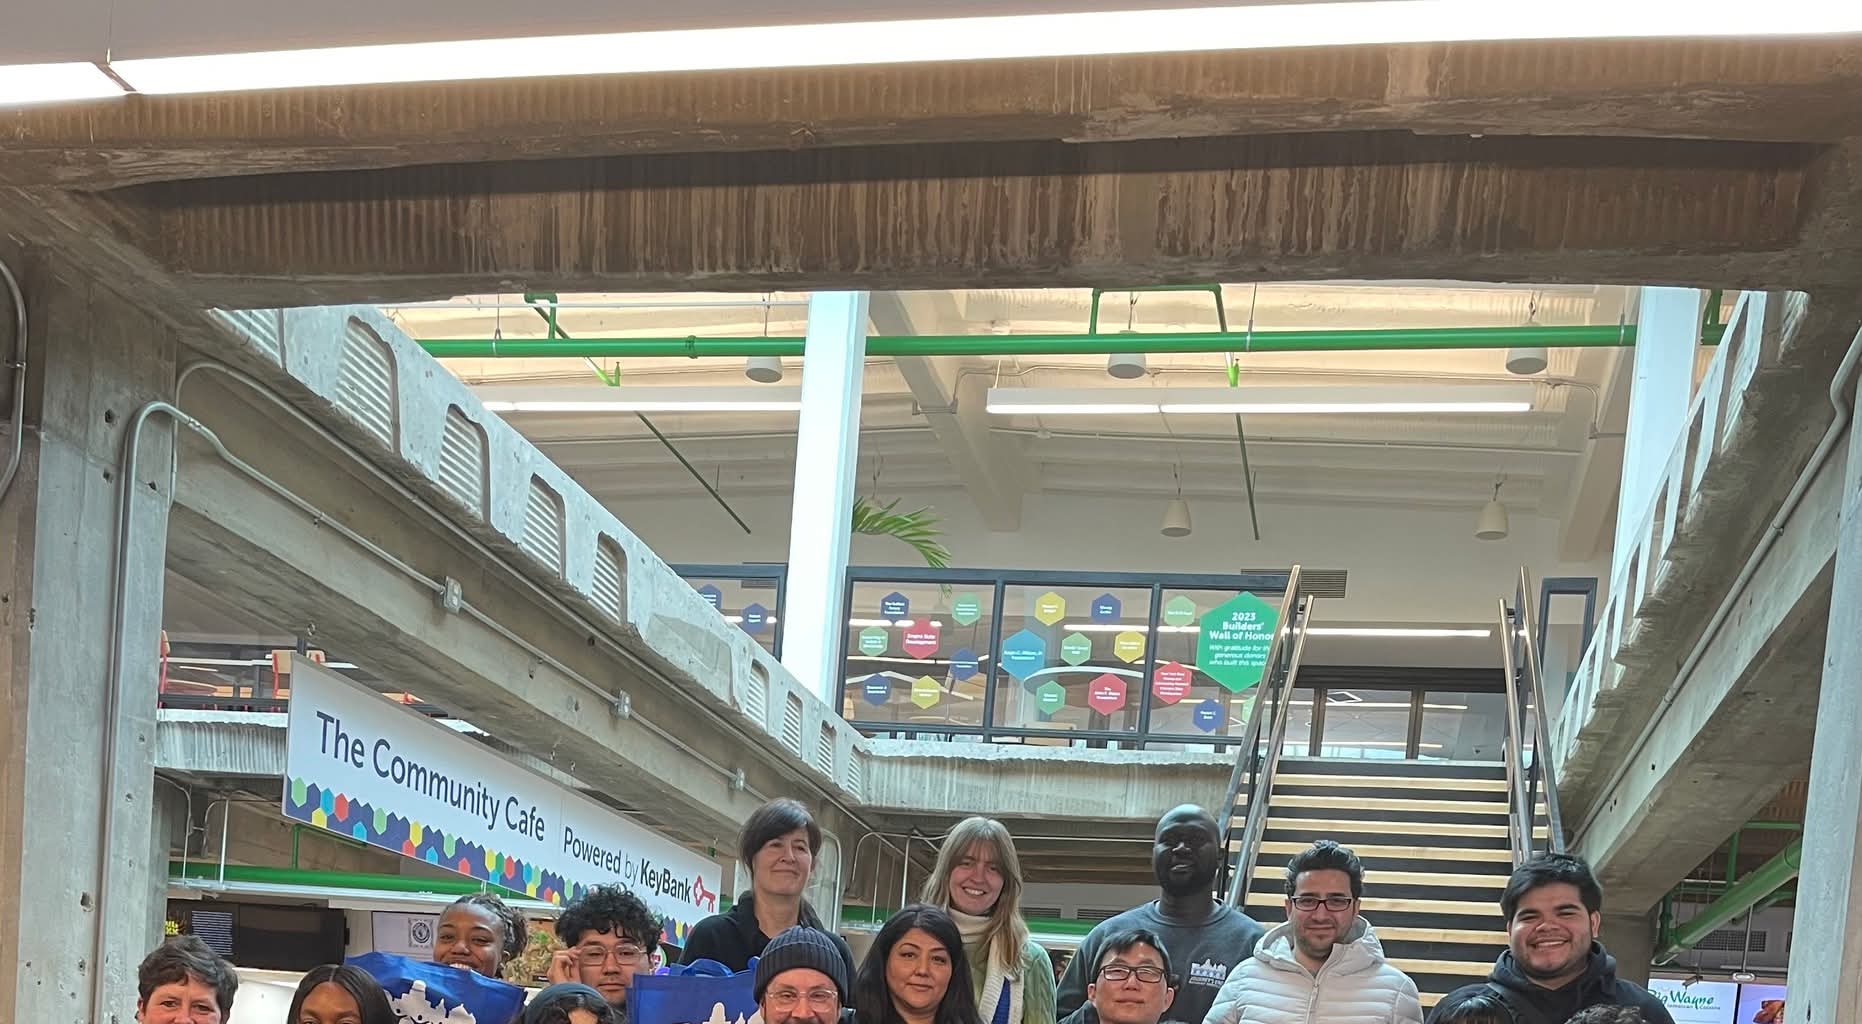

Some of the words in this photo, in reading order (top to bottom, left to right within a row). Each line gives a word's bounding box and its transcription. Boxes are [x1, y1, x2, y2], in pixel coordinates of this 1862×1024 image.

[1232, 612, 1256, 621] 2023
[1222, 621, 1264, 631] Builders'
[1209, 630, 1230, 640] Wall
[1232, 631, 1243, 640] of
[316, 710, 365, 769] The
[372, 738, 500, 831] Community
[505, 796, 545, 842] Cafe
[563, 826, 622, 875] Powered
[624, 853, 639, 888] by
[640, 858, 691, 904] KeyBank
[1670, 990, 1714, 1010] Wayne
